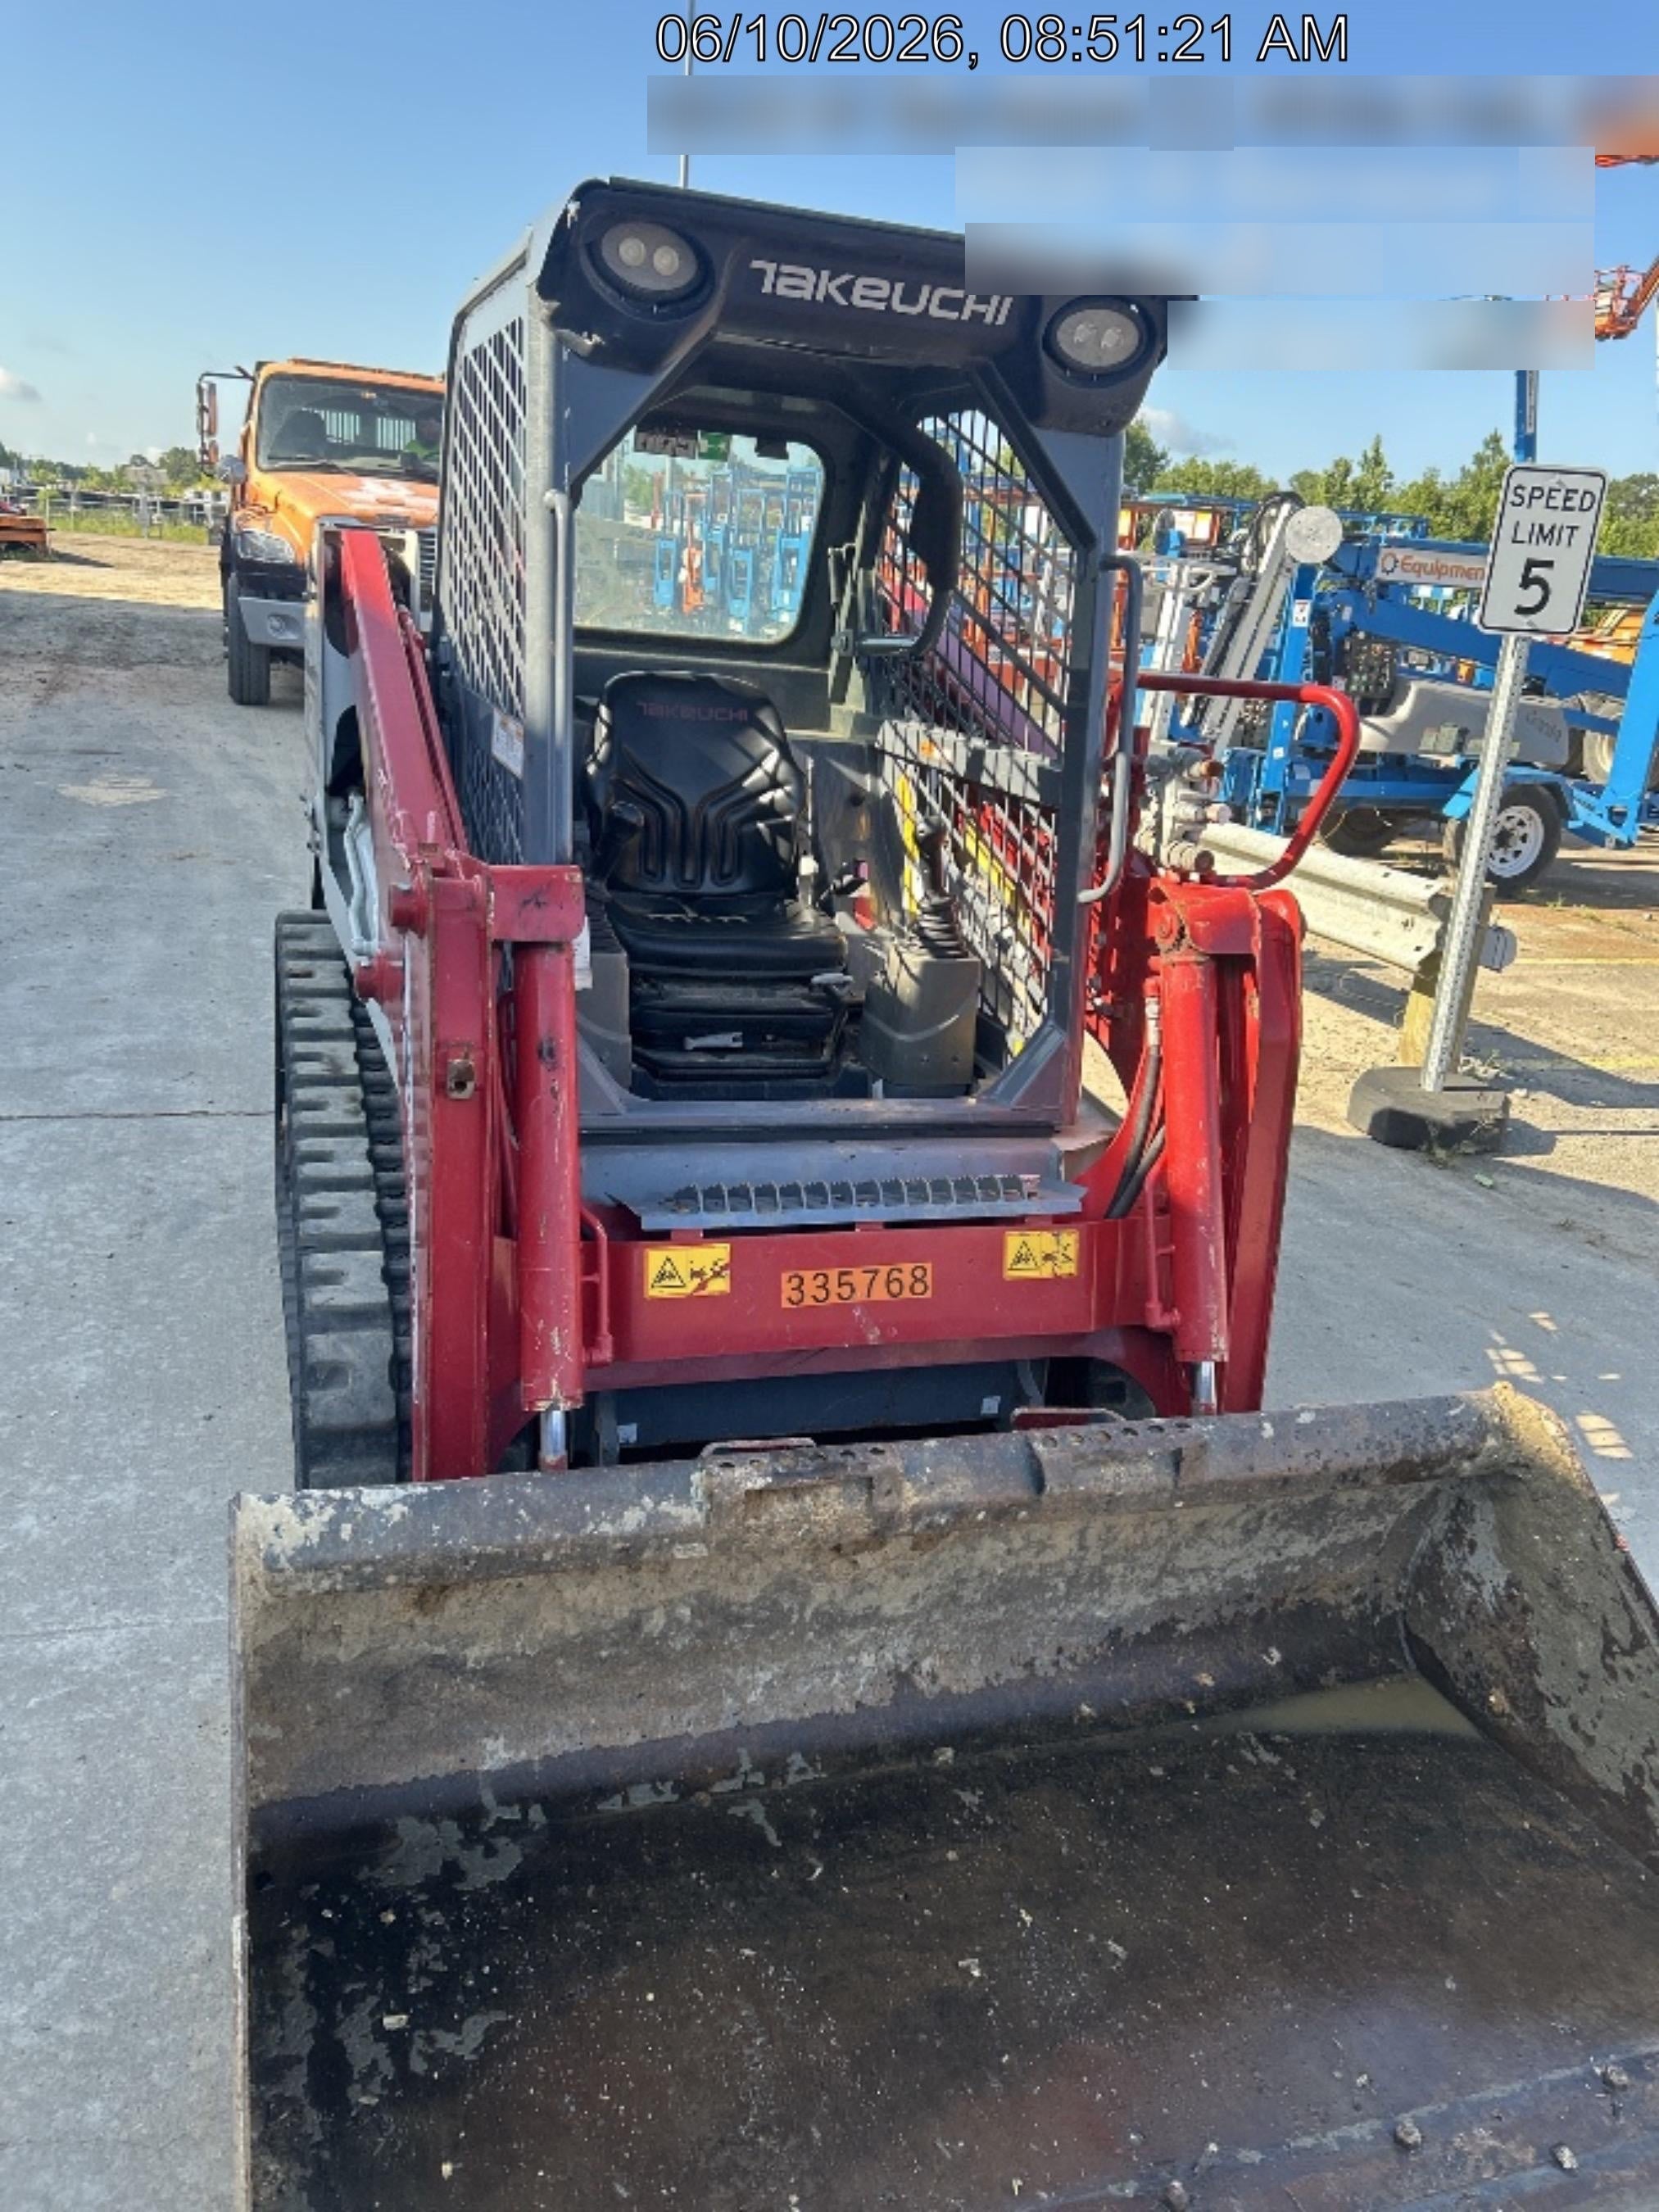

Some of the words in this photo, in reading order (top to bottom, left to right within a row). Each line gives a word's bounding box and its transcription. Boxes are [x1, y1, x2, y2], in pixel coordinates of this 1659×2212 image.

[749, 260, 1014, 326] TAKEUCHI
[1509, 484, 1597, 512] SPEED
[1511, 520, 1580, 548] LIMIT
[1514, 558, 1554, 615] 5
[786, 1265, 929, 1306] 335768
